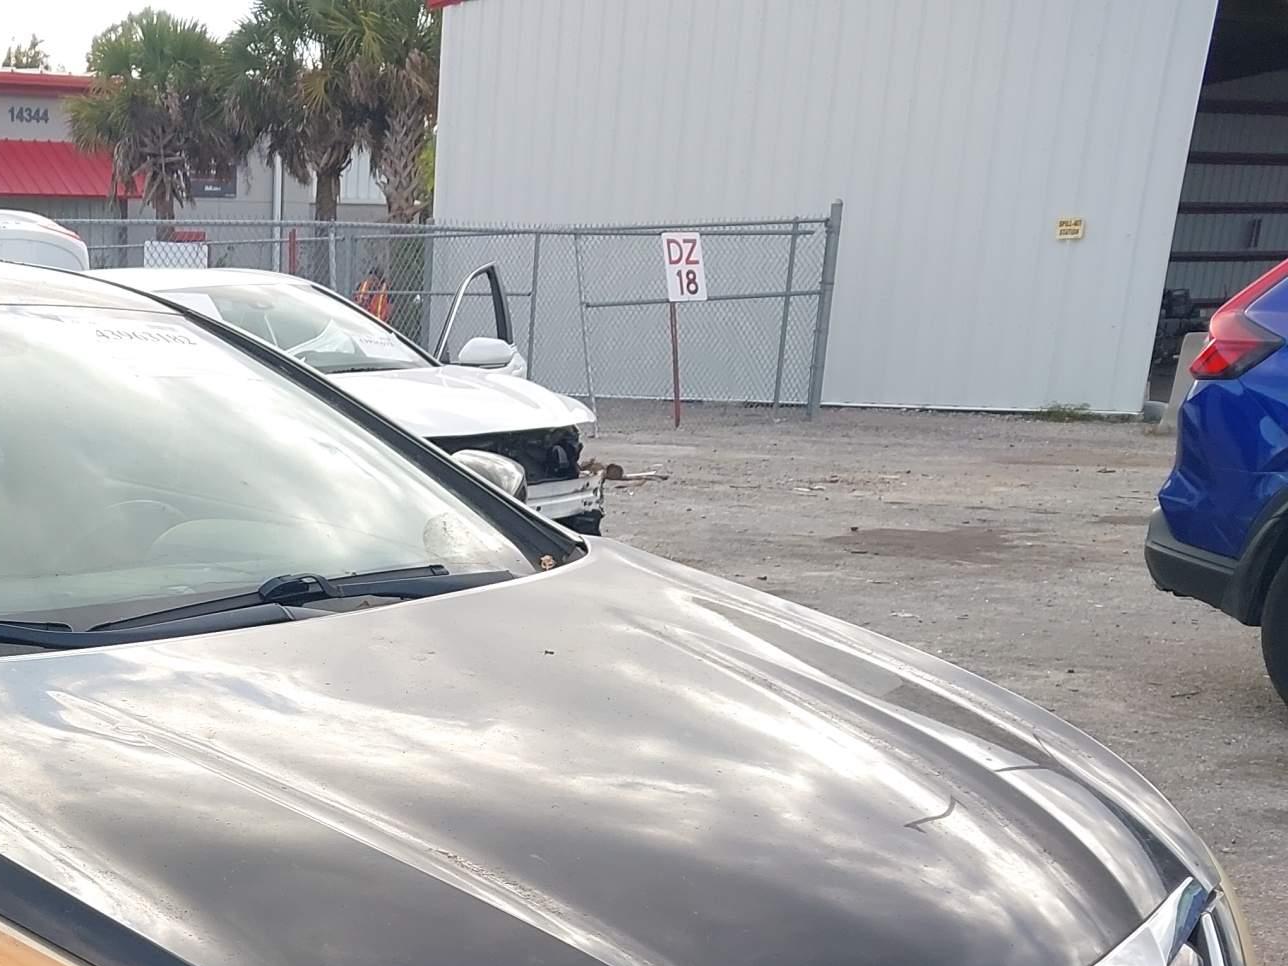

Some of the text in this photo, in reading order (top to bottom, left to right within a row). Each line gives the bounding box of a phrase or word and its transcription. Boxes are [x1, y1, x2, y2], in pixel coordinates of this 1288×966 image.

[8, 106, 50, 124] 14344
[666, 239, 700, 265] DZ
[676, 269, 699, 296] 18
